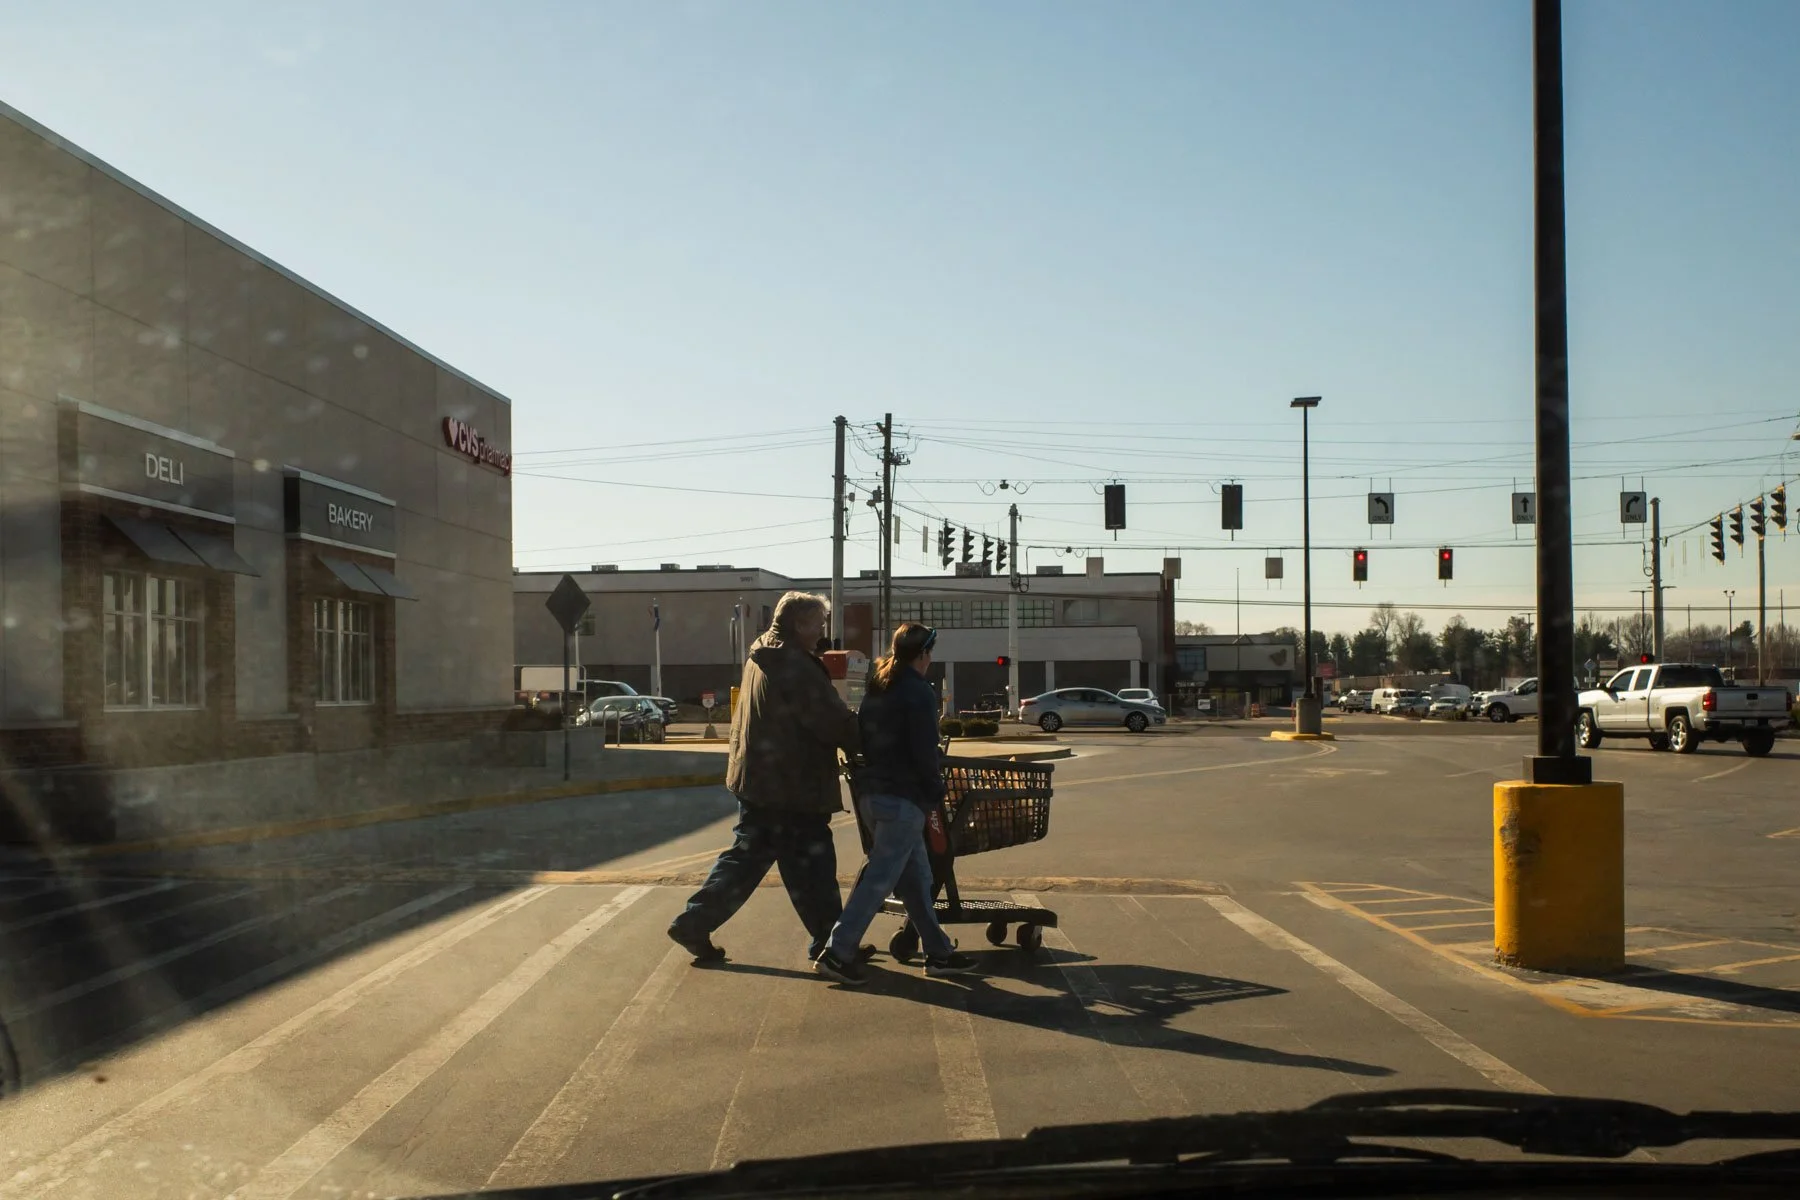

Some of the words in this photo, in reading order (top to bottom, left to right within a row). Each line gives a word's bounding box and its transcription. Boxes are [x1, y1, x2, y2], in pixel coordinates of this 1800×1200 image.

[459, 422, 479, 457] CVS
[479, 442, 511, 471] pharmac
[146, 453, 184, 486] DELI
[328, 503, 374, 532] BAKERY
